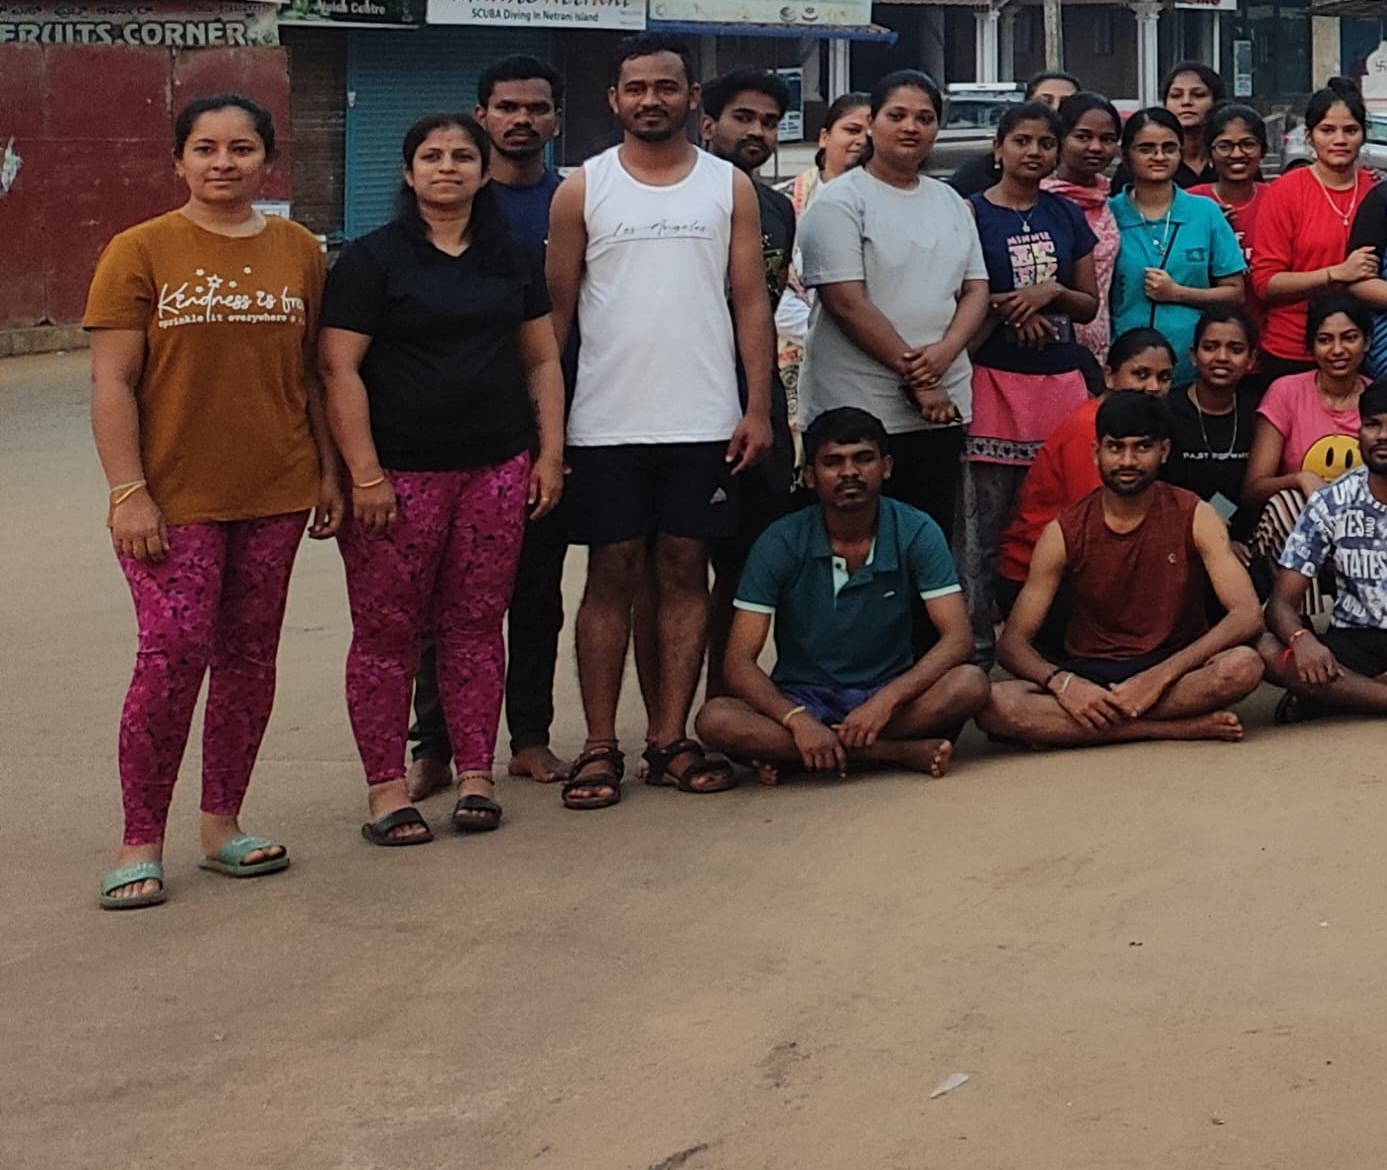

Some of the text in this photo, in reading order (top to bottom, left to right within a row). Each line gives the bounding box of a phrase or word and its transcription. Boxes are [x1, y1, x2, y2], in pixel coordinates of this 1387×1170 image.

[472, 8, 501, 20] SCUBA
[504, 9, 531, 22] Diving
[543, 10, 573, 22] Netrani
[574, 11, 599, 22] Island
[122, 21, 247, 47] CORNER
[158, 282, 252, 321] Kindness
[256, 290, 276, 310] is
[158, 312, 288, 329] sprinkle it everywhere
